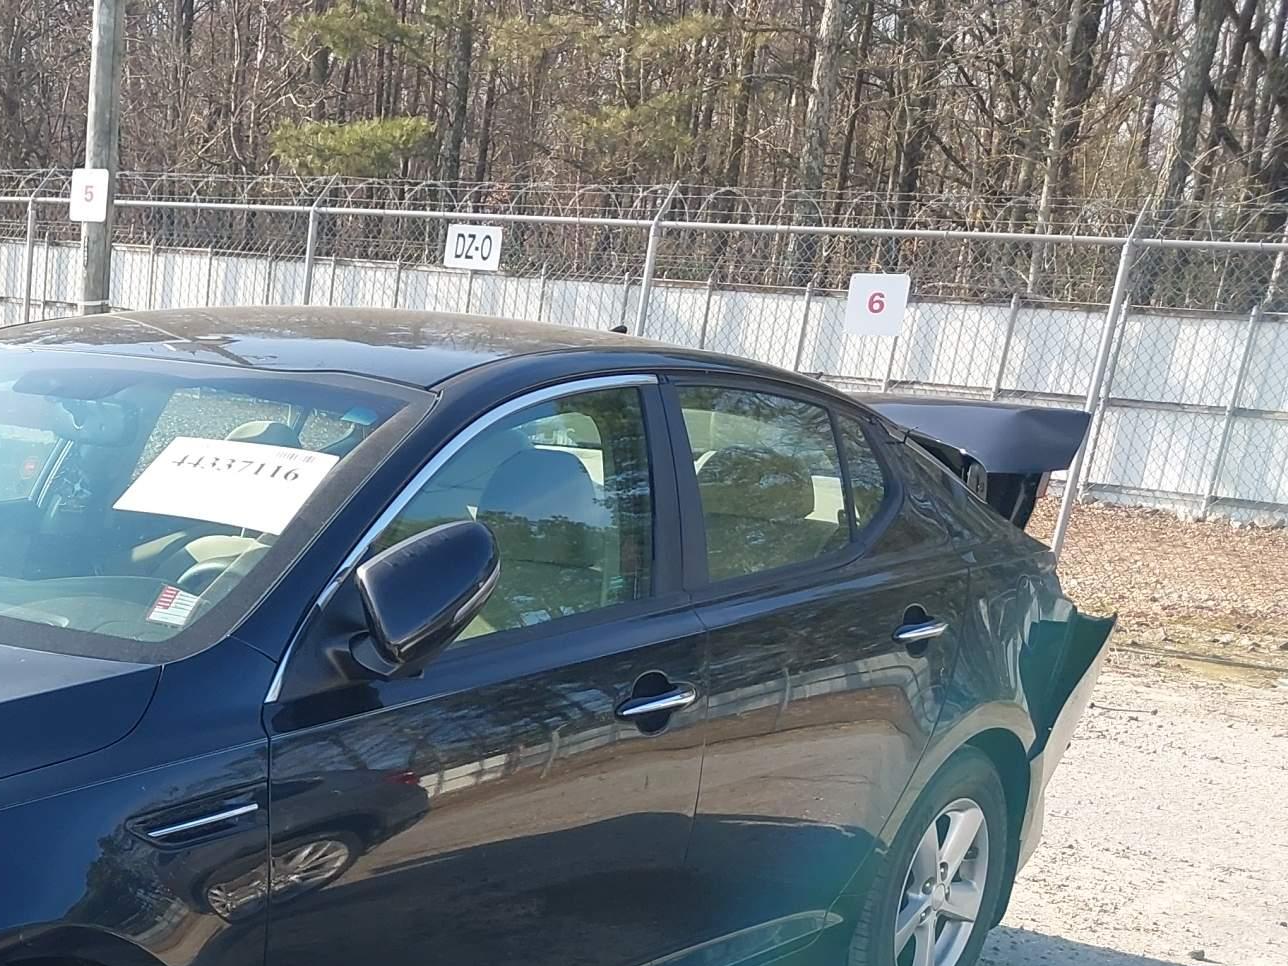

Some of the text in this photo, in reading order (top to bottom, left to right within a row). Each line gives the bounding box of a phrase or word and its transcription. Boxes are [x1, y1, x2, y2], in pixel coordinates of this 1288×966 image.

[84, 185, 94, 202] 5
[868, 292, 885, 314] 6
[172, 454, 299, 481] 44337116
